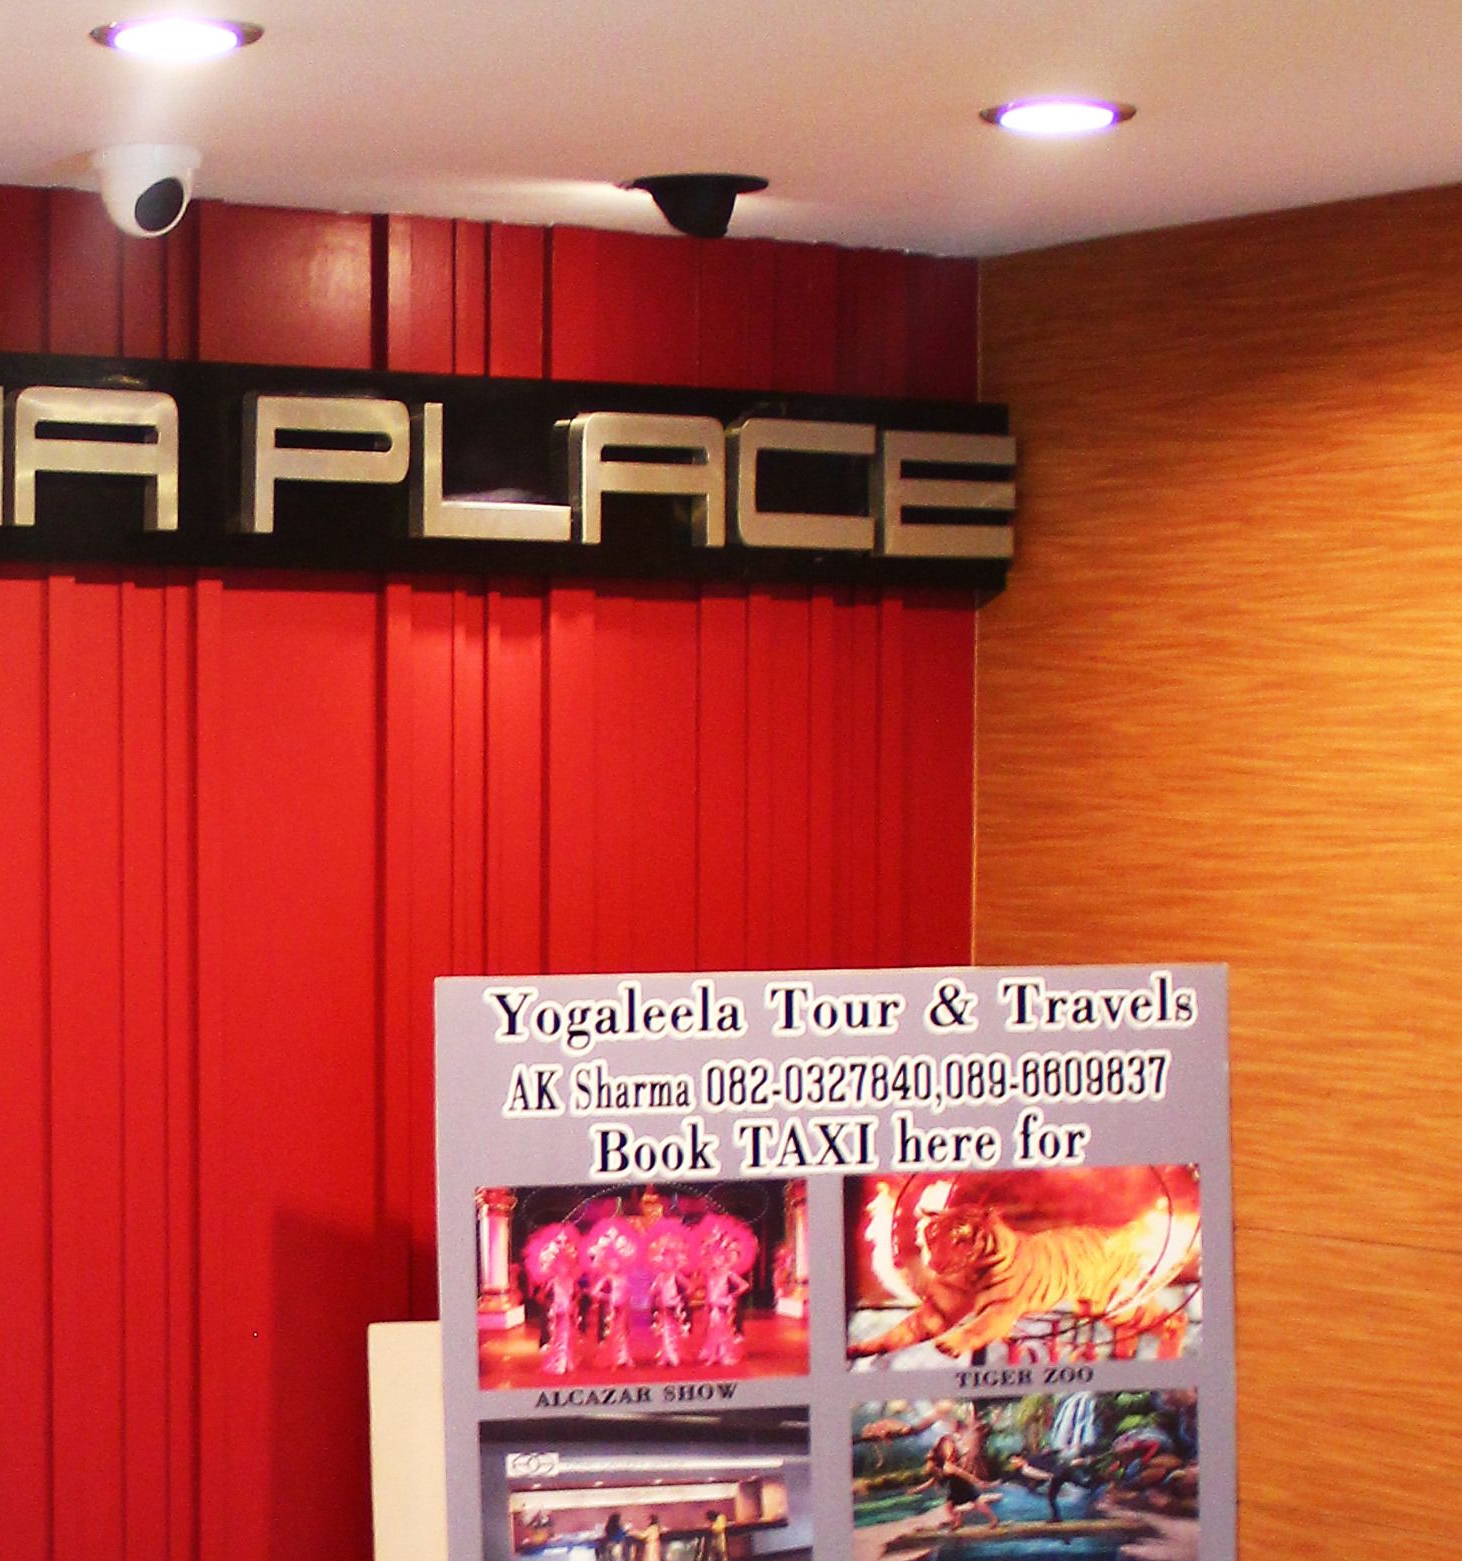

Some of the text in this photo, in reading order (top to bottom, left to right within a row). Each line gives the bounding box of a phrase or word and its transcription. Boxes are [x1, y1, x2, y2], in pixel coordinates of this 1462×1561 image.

[242, 395, 1017, 559] PLACE
[493, 979, 1195, 1048] Yogaleela Tour & Travels
[506, 1069, 559, 1111] AK
[574, 1064, 691, 1109] Sharma
[595, 1114, 1087, 1174] Book TAXI here for
[535, 1382, 739, 1408] ALCAZAR SHOW
[955, 1366, 1094, 1388] TIGER ZOO
